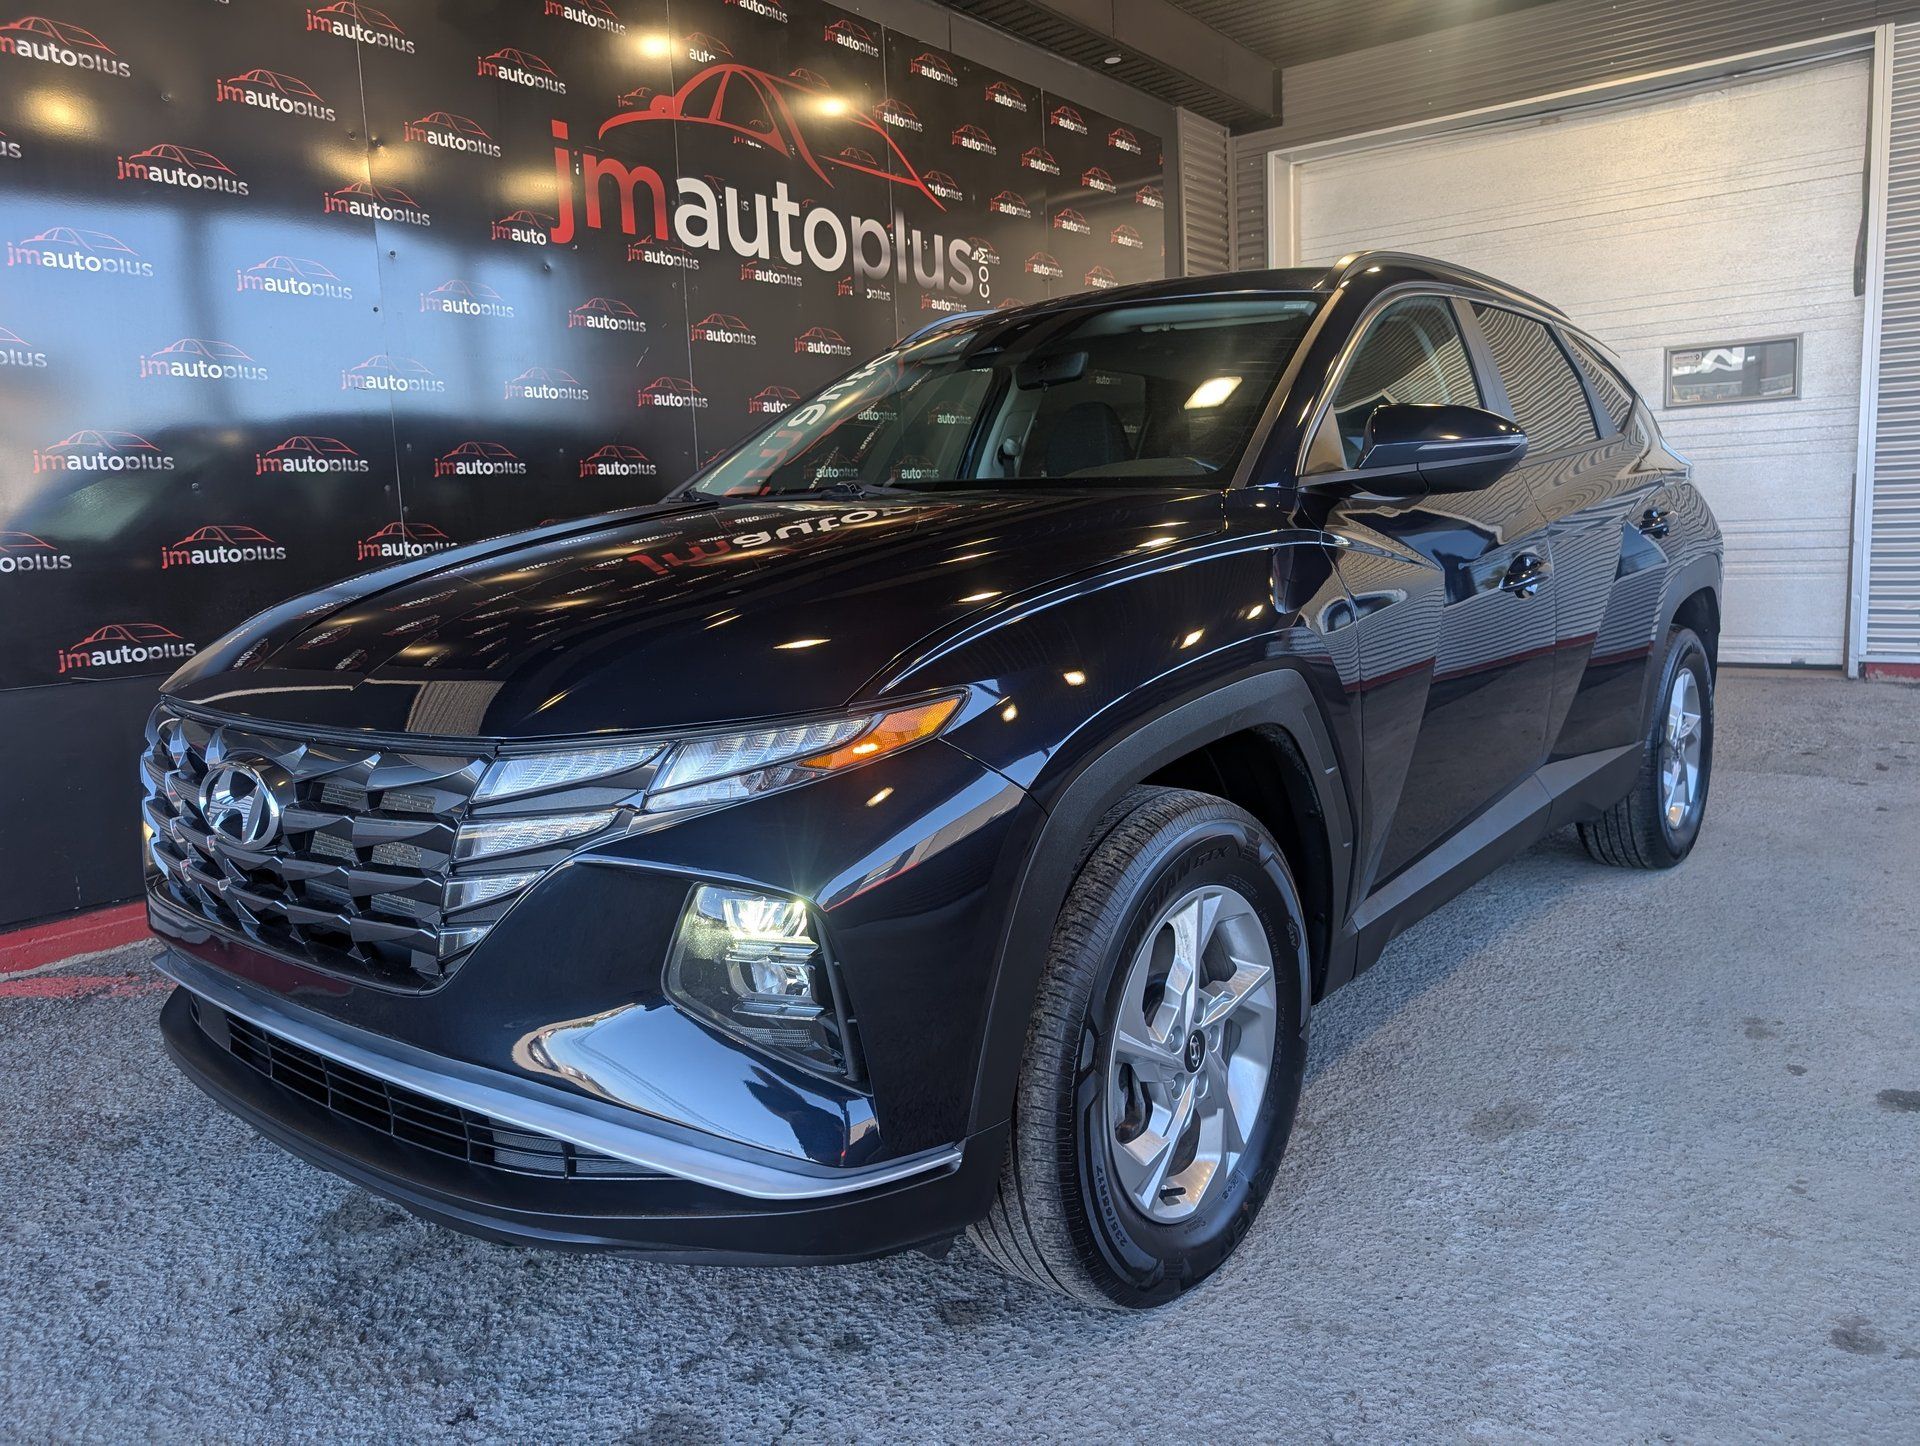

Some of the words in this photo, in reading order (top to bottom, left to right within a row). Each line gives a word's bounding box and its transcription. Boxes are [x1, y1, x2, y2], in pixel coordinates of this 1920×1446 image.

[544, 0, 626, 36] jmautoplus
[306, 9, 415, 54] jmautoplus
[824, 26, 879, 58] jmautoplus
[477, 56, 567, 95] jmautoplus
[910, 59, 958, 88] jmautoplus
[216, 79, 336, 122] jmautoplus
[985, 87, 1027, 112] jmautoplus
[1050, 111, 1088, 135] jmautoplus
[403, 121, 501, 158] jmautoplus
[952, 130, 997, 156] jmautoplus
[1108, 131, 1141, 155] jmautoplus
[117, 156, 249, 197] jmautoplus
[1021, 153, 1061, 176] jmautoplus
[1081, 172, 1117, 194] jmautoplus
[323, 191, 431, 227] jmautoplus
[550, 119, 975, 296] jmautoplus
[978, 247, 991, 305] .COM
[990, 196, 1031, 219] jmautoplus
[1053, 215, 1091, 236] jmautoplus
[7, 241, 153, 277] jmautoplus
[627, 244, 700, 271] jmautoplus
[236, 270, 353, 300] jmautoplus
[740, 264, 802, 287] jmautoplus
[420, 293, 514, 318] jmautoplus
[921, 294, 967, 312] jmautoplus
[568, 310, 646, 333] jmautoplus
[691, 320, 757, 346] jmautoplus
[793, 337, 851, 357] jmautoplus
[139, 355, 268, 381] jmautoplus
[341, 368, 445, 393] jmautoplus
[504, 381, 589, 401] jmautoplus
[637, 390, 708, 409] jmautoplus
[33, 450, 175, 475] jmautoplus
[255, 453, 369, 475] jmautoplus
[434, 458, 527, 478] jmautoplus
[579, 460, 657, 478] jmautoplus
[161, 545, 286, 569] jmautoplus
[58, 640, 196, 674] jmautoplus
